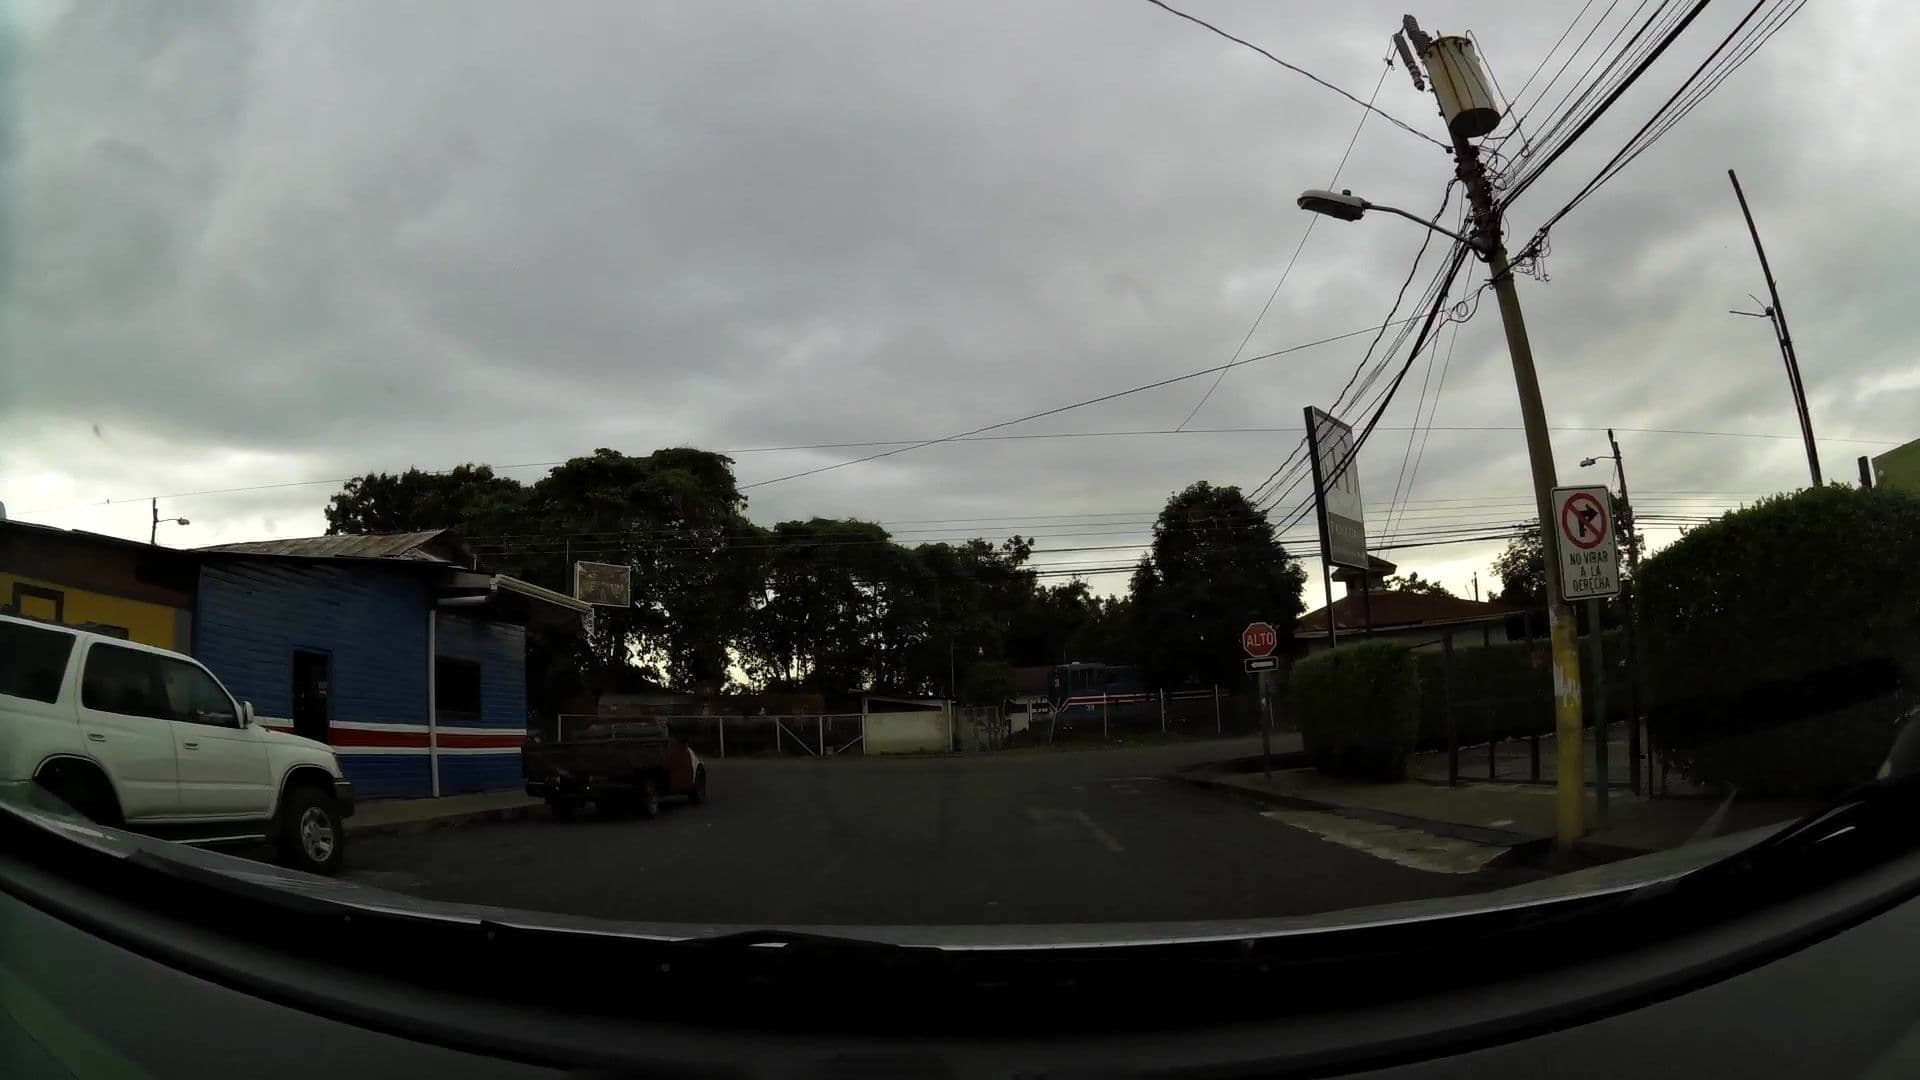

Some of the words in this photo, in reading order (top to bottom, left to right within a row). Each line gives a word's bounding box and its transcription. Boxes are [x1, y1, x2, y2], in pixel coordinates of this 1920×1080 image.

[1570, 552, 1581, 565] NO
[1584, 551, 1608, 564] VIRAR
[1581, 566, 1586, 577] A
[1591, 565, 1601, 576] LA
[1573, 577, 1611, 593] DERECHA
[1247, 632, 1273, 648] ALTO
